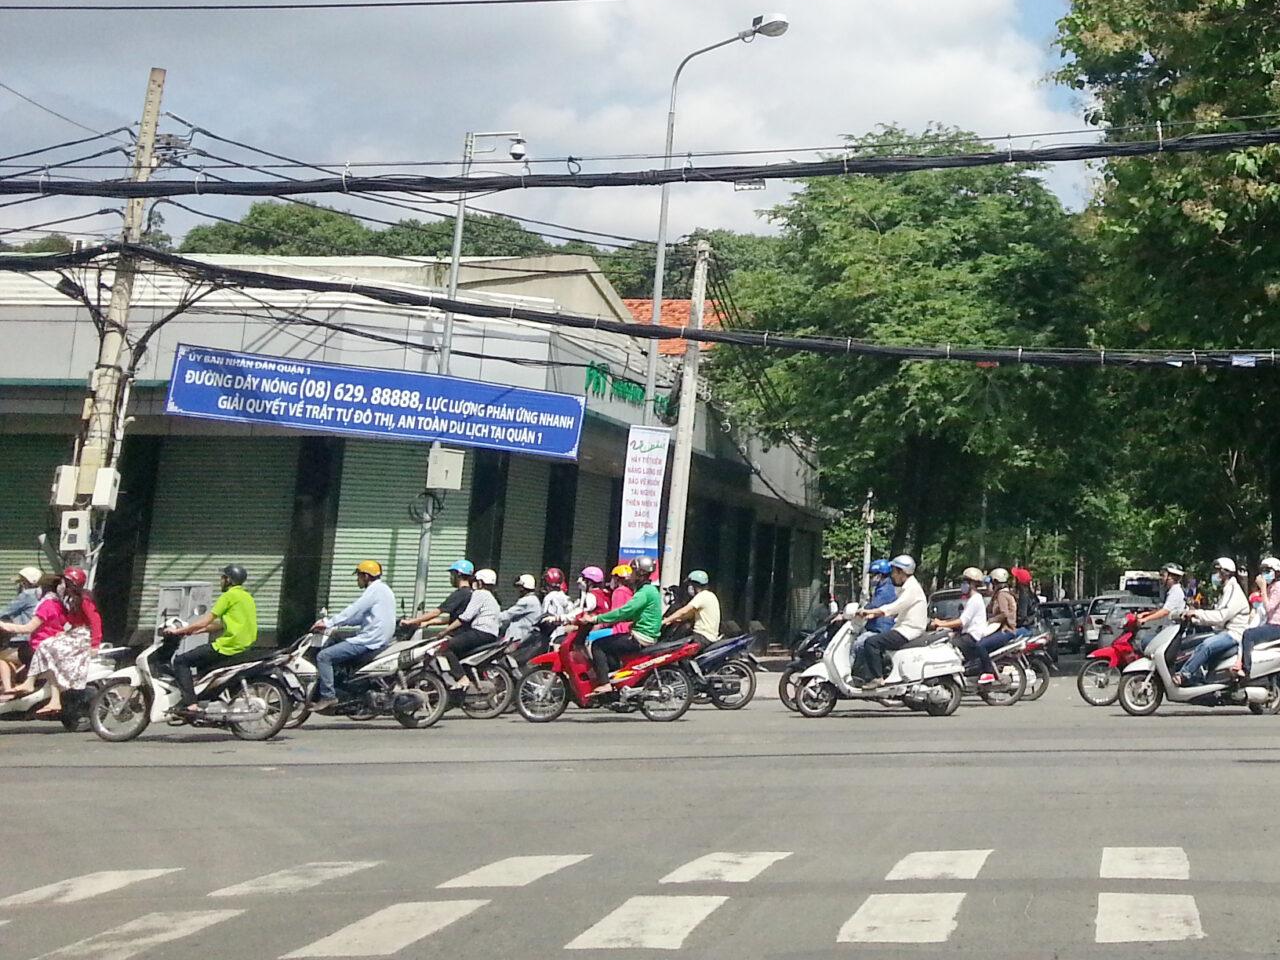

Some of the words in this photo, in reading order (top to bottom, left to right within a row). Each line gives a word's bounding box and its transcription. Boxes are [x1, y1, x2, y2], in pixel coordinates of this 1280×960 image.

[203, 355, 224, 365] BAN
[225, 357, 254, 369] NHÂN
[254, 360, 276, 371] DÂN
[276, 363, 305, 375] QUẬN
[306, 367, 311, 375] 1
[185, 368, 232, 389] ĐƯỜNG
[234, 373, 261, 391] DÂY
[261, 376, 298, 395] NÓNG
[299, 378, 331, 402] (08)
[333, 383, 367, 404] 629.
[370, 386, 423, 412] 88888,
[425, 396, 448, 415] LỰC
[449, 398, 485, 418] LƯỢNG
[486, 402, 514, 421] PHẢN
[515, 405, 539, 425] ỨNG
[539, 413, 575, 430] NHANH
[218, 392, 244, 411] GIẢI
[246, 397, 288, 417] QUYẾT
[289, 399, 303, 417] VỀ
[305, 403, 334, 424] TRẬT
[335, 406, 353, 426] TỰ
[354, 408, 373, 424] ĐÔ
[374, 412, 395, 431] THỊ,
[397, 415, 415, 430] AN
[417, 415, 448, 433] TOÀN
[449, 420, 465, 434] DU
[466, 422, 489, 440] LỊCH
[490, 425, 505, 440] TẠI
[507, 426, 535, 446] QUẬN
[536, 431, 543, 445] 1
